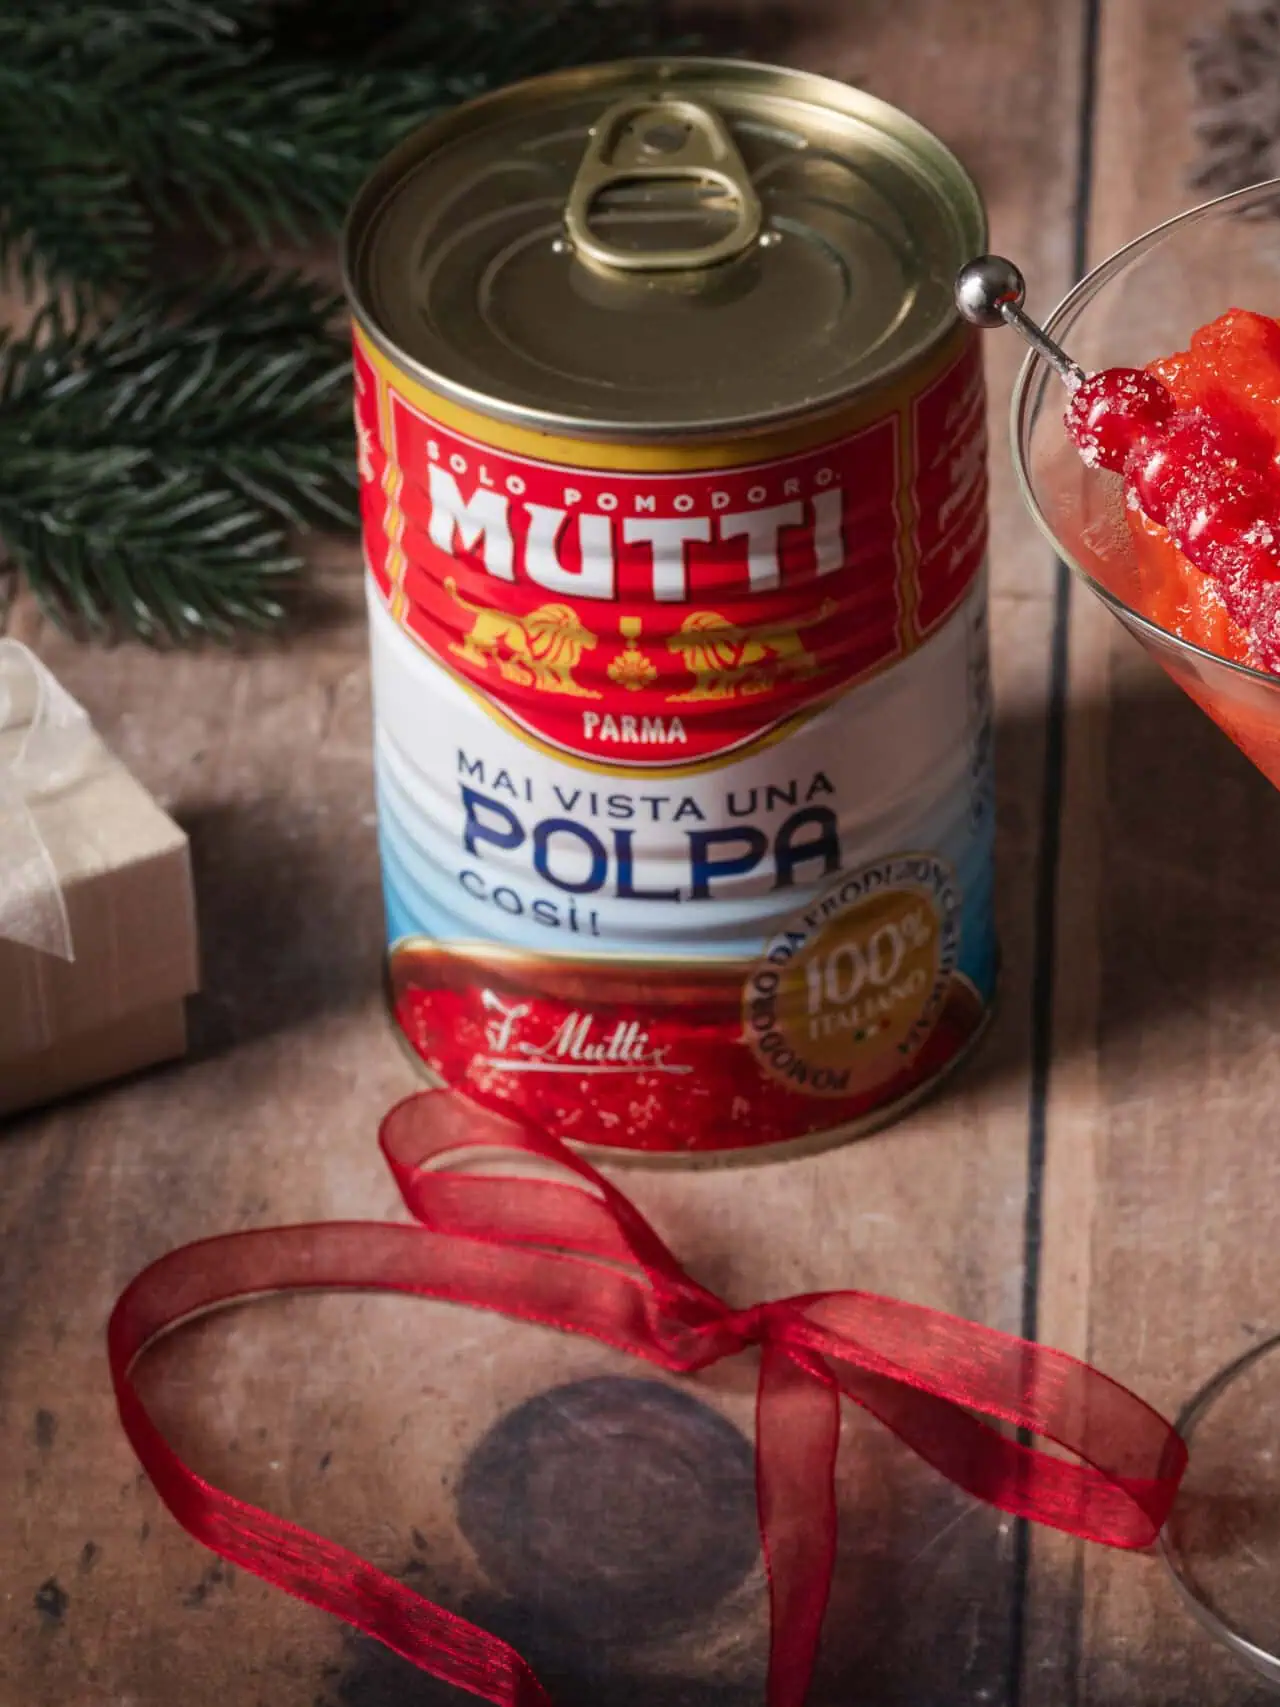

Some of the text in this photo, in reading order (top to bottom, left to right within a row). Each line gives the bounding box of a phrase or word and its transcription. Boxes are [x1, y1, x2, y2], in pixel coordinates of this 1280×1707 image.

[426, 439, 527, 496] SOLO
[427, 461, 847, 603] MUTTI
[582, 710, 688, 746] PARMA
[456, 748, 836, 823] MAI VISTA UNA
[459, 782, 843, 903] POLPA
[767, 930, 806, 967] DA
[805, 908, 933, 1018] 100%
